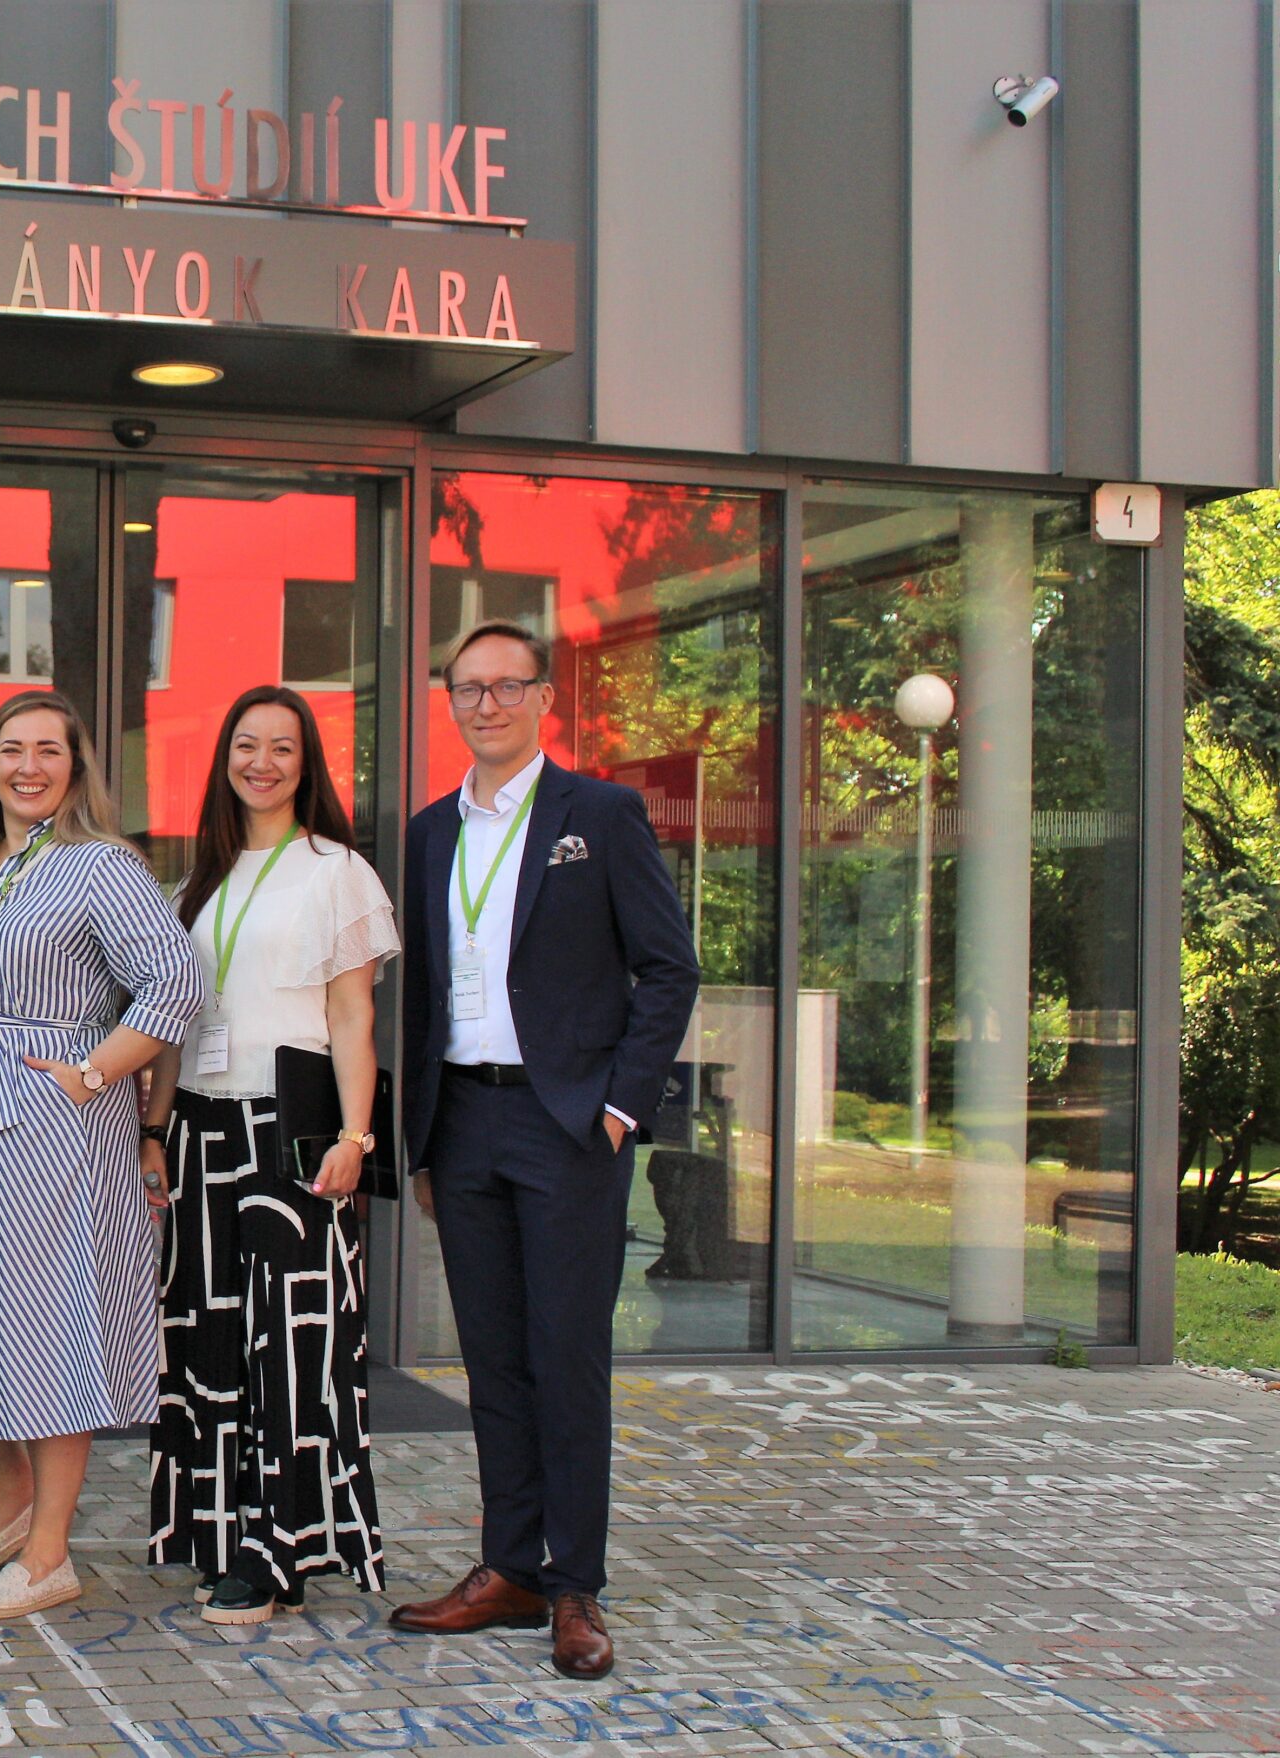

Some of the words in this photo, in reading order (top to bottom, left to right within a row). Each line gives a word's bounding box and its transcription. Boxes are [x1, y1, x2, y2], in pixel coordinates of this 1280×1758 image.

[109, 77, 345, 206] ŠTÚDIÍ
[375, 118, 508, 217] UKF
[337, 264, 522, 341] KARA
[1123, 495, 1133, 528] 4
